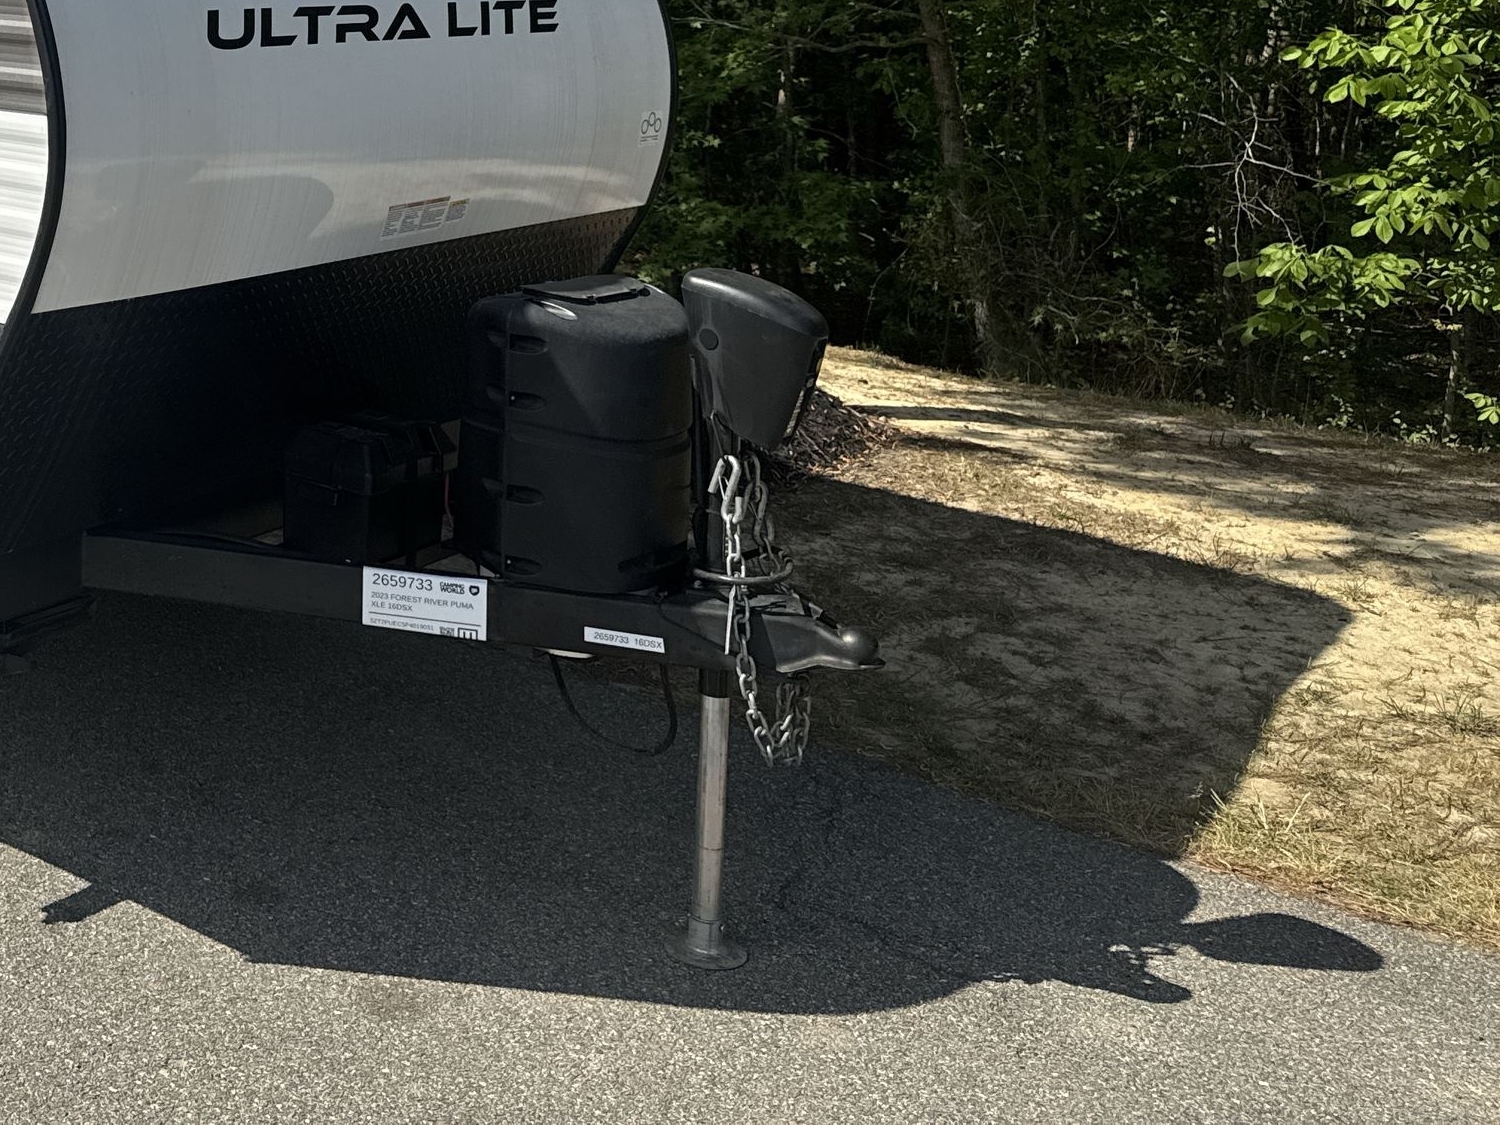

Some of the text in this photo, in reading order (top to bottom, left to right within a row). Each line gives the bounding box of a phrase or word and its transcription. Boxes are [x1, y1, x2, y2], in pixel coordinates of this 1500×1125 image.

[206, 0, 560, 51] ULTRA LITE
[372, 572, 433, 591] 2659733
[439, 581, 465, 589] CAMPING
[440, 586, 465, 594] WORLD
[371, 591, 474, 610] 2023 FOREST RIVER PUMA
[371, 601, 412, 611] XLE 16DSX
[594, 631, 662, 649] 2659733 16DSX
